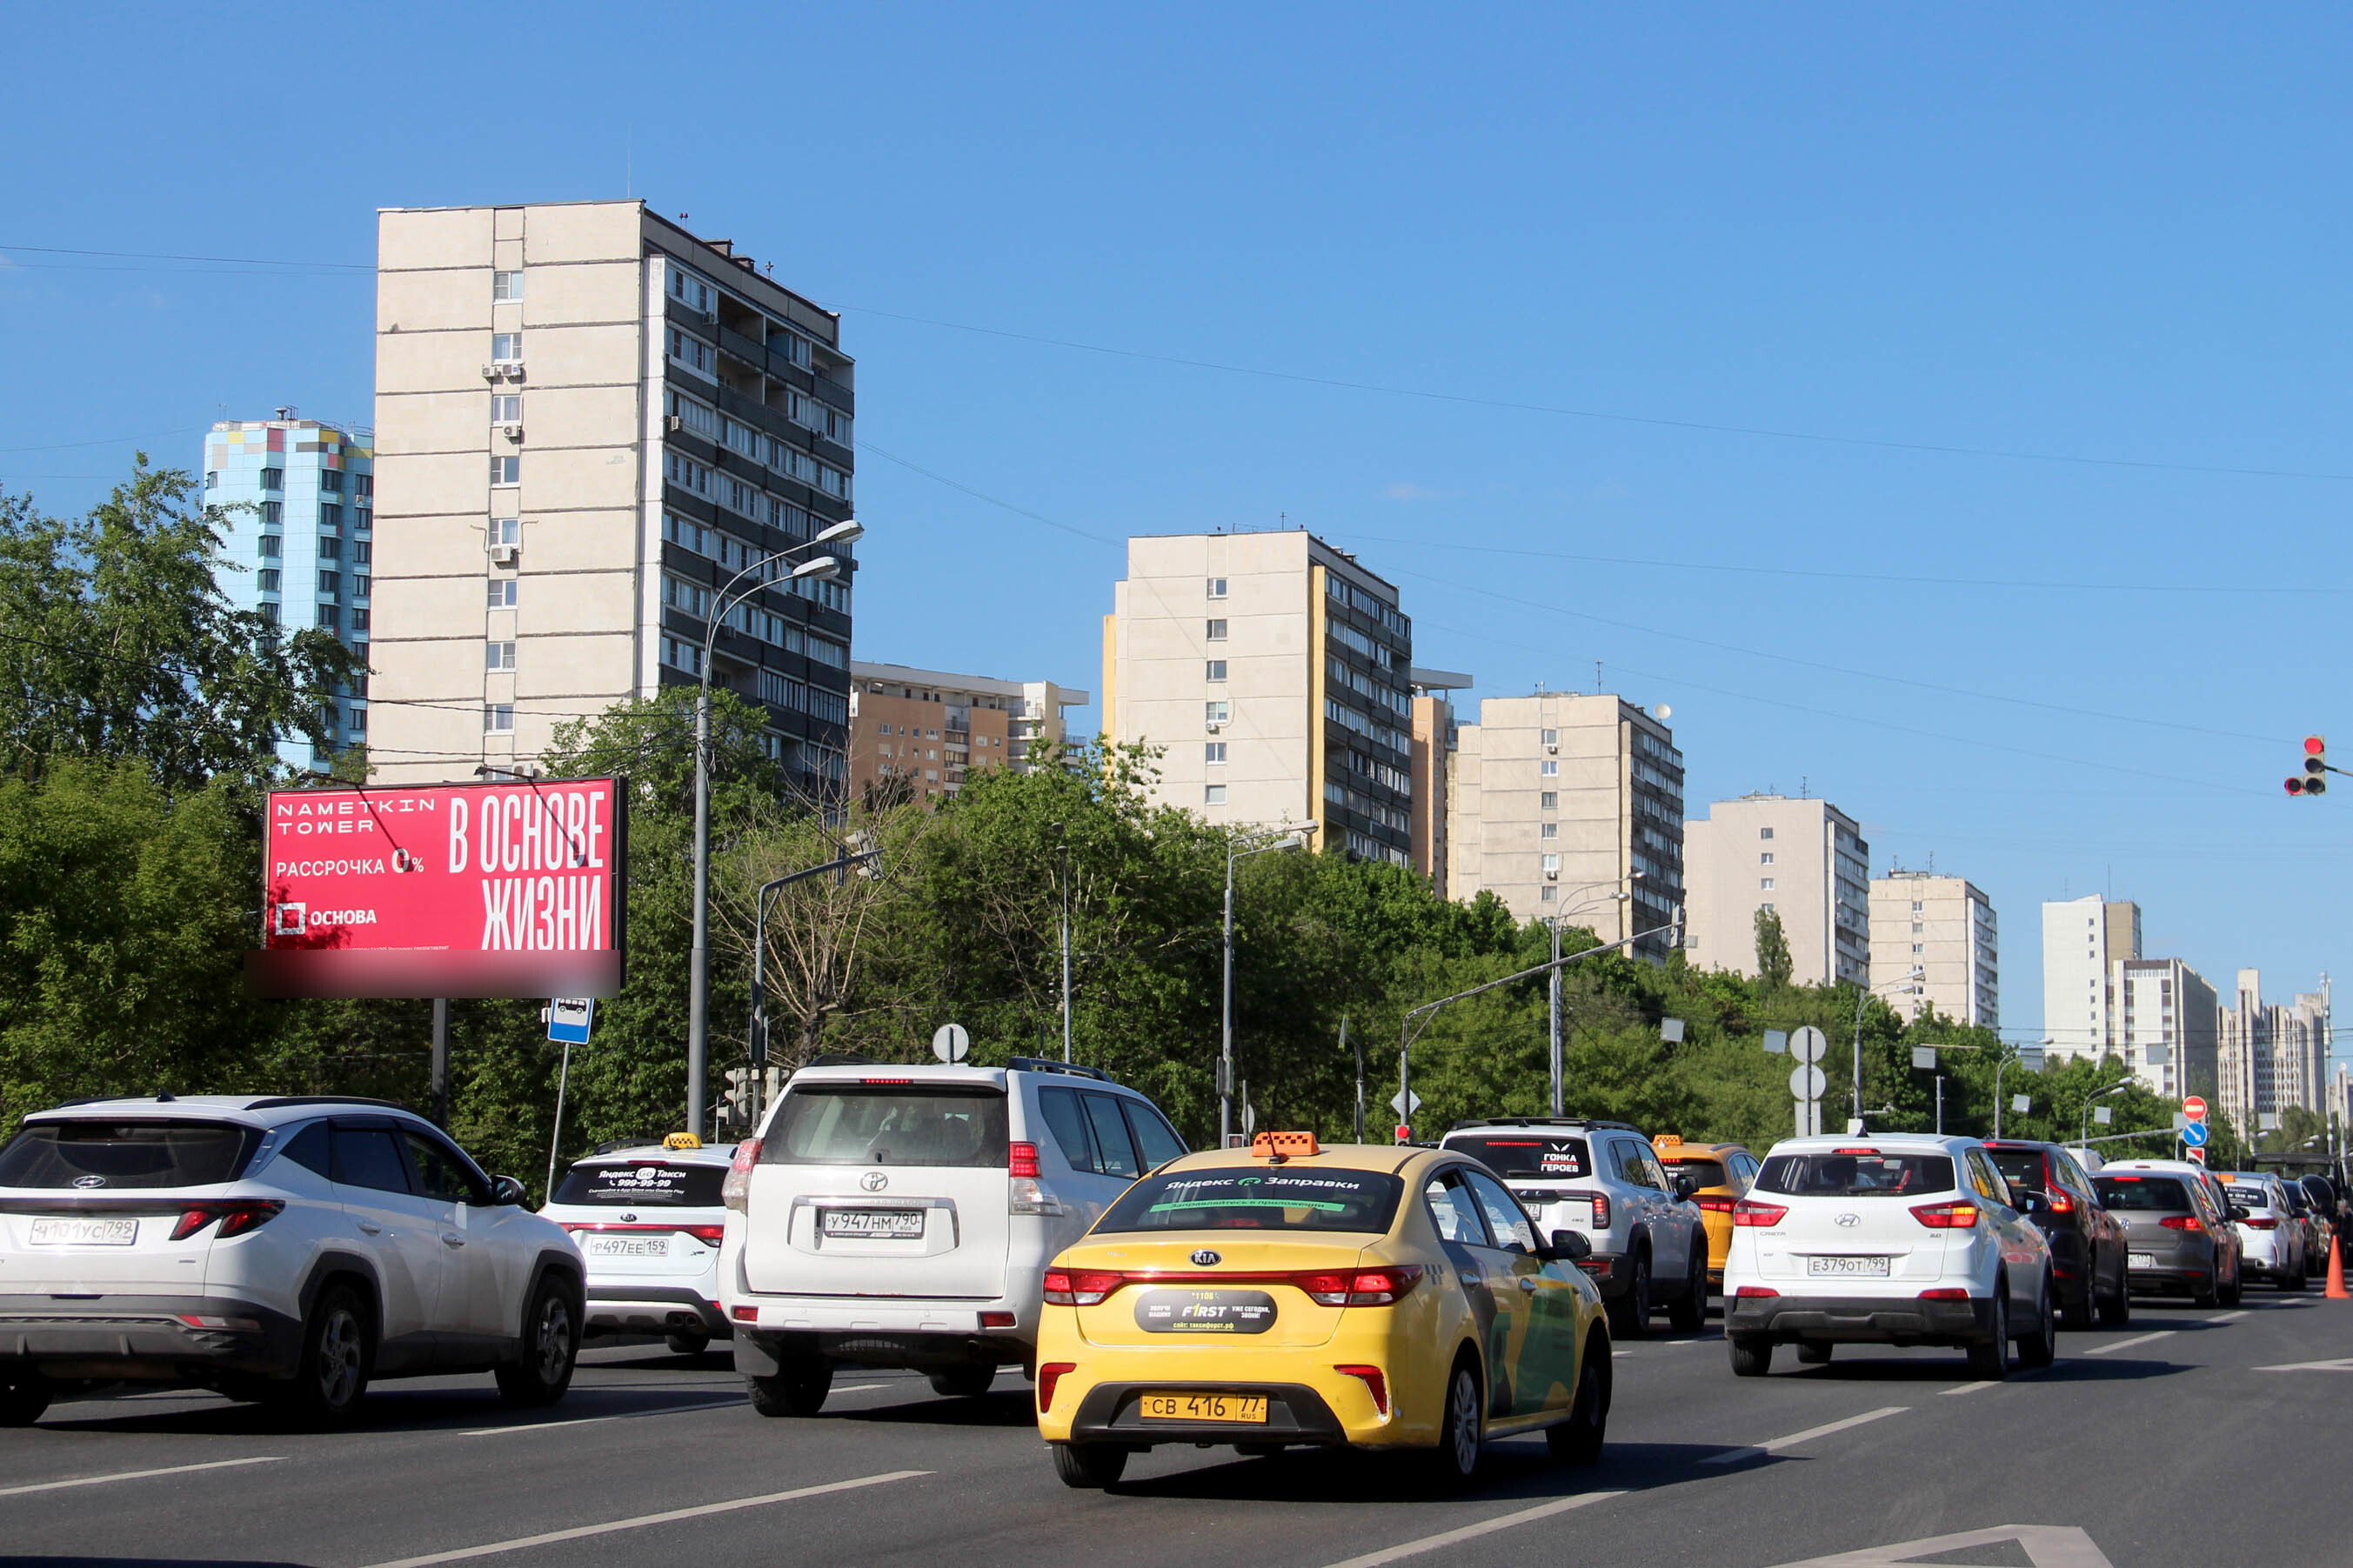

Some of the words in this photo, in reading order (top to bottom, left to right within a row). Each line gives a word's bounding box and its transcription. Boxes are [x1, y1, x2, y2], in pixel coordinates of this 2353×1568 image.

[277, 798, 435, 817] NAMETKIN
[277, 819, 374, 836] TOWER
[449, 797, 469, 874] В
[479, 791, 605, 872] ОСНОВЕ
[276, 859, 384, 877] РАССРОЧКА
[310, 909, 377, 926] ОСНОВА
[481, 875, 602, 950] ЖИЗНИ
[1543, 1153, 1577, 1163] ГОНКА
[598, 1170, 635, 1179] Яндекс
[657, 1169, 686, 1178] Такси
[1541, 1164, 1579, 1173] ГЕРОЕВ
[617, 1178, 672, 1187] 999-99-99
[1165, 1178, 1234, 1191] Яндекс
[1264, 1177, 1360, 1190] Заправки
[107, 1221, 131, 1235] 799
[832, 1213, 892, 1229] У947НМ
[895, 1213, 918, 1225] 790
[595, 1241, 643, 1253] Р497ЕЕ
[646, 1241, 665, 1251] 159
[1194, 1252, 1217, 1264] KIA
[1813, 1259, 1862, 1271] Е379ОТ
[1866, 1258, 1885, 1269] 799
[1187, 1396, 1226, 1417] 416
[1240, 1397, 1260, 1412] 77
